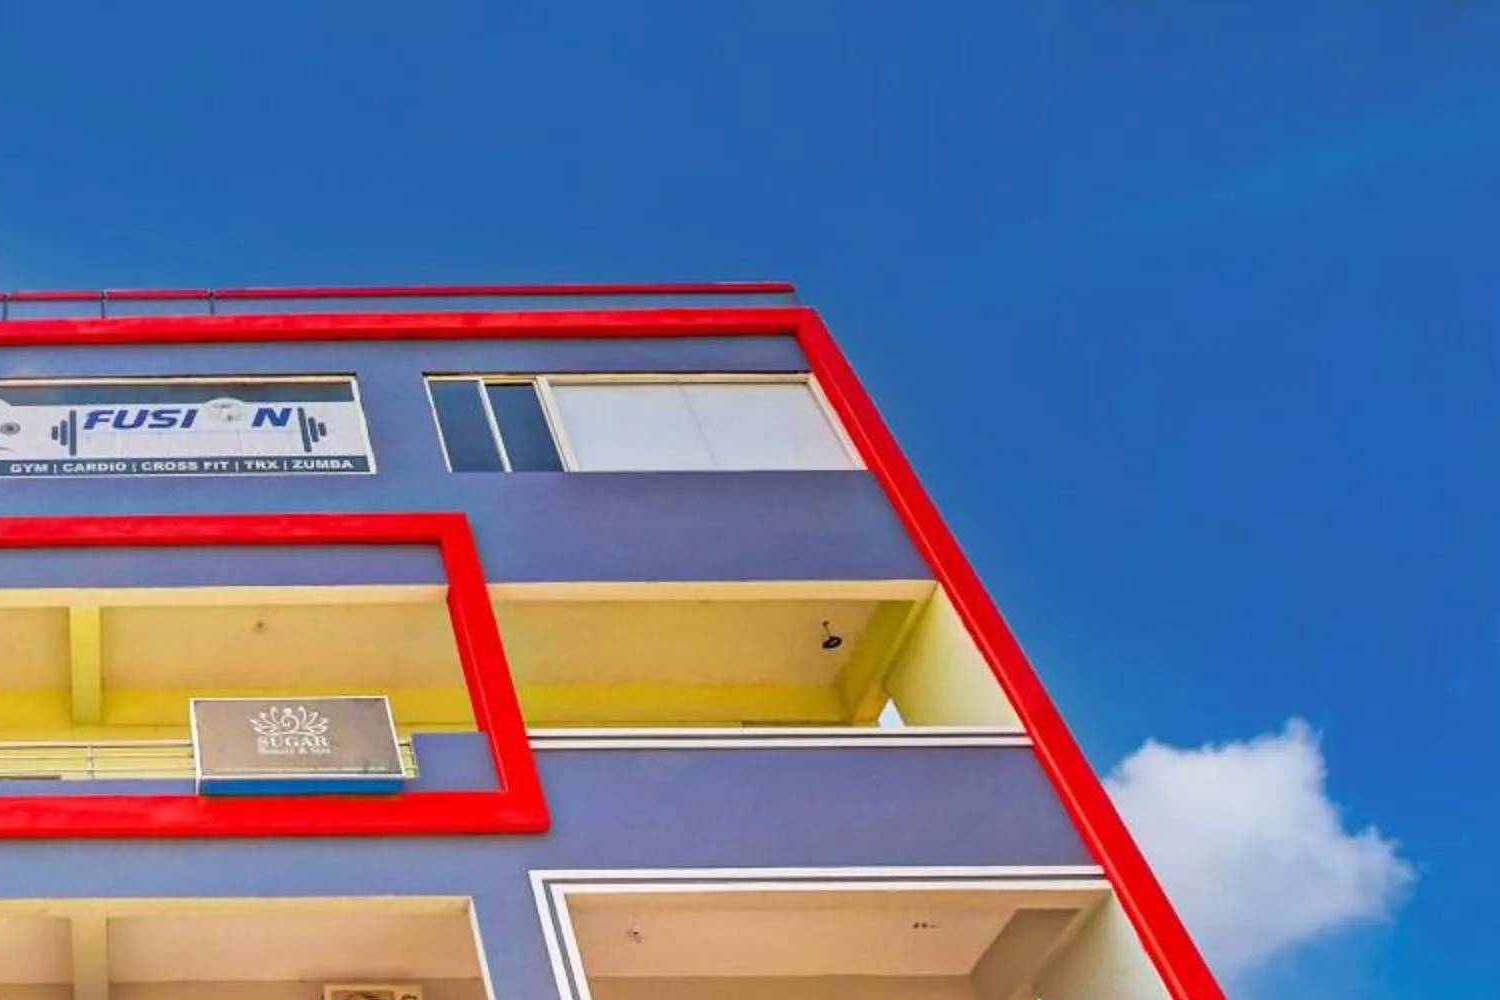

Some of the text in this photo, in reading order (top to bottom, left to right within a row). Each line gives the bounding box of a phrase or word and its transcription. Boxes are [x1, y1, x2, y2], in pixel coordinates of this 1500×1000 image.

[10, 459, 355, 473] GYM CARDIO CROSS FIT TRX ZUMBA
[258, 734, 330, 748] SUGAR
